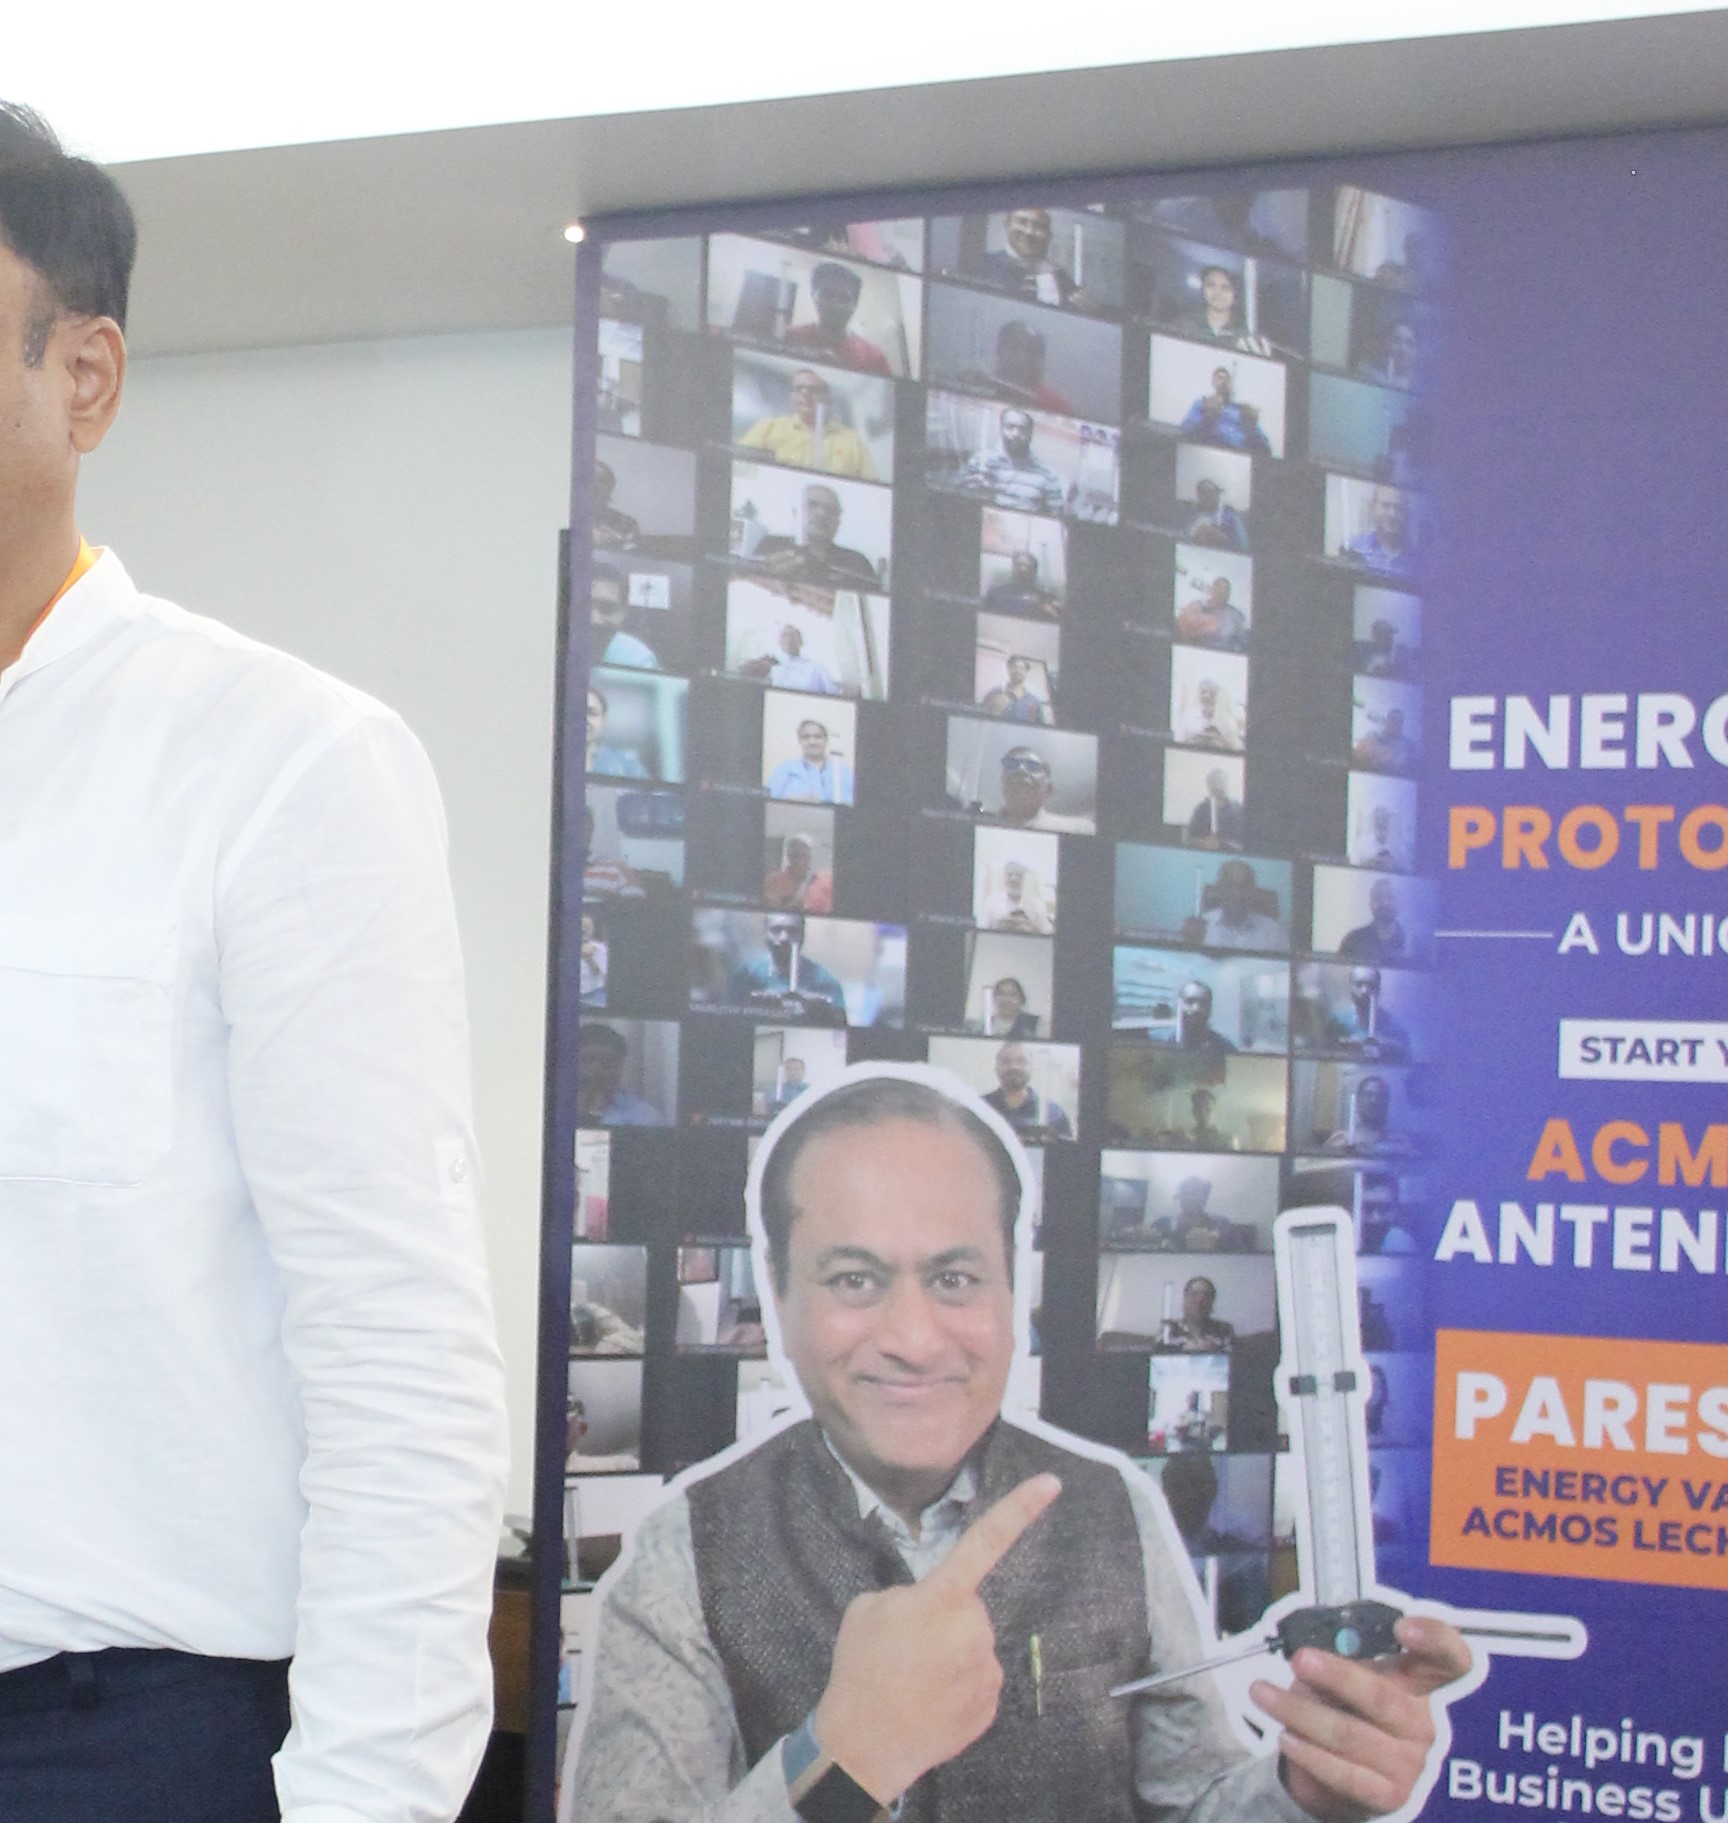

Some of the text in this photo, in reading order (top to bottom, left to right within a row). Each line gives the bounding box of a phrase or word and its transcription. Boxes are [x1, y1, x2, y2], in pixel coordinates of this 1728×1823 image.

[1448, 803, 1728, 871] PROTO
[1558, 911, 1728, 956] A UNI
[1580, 1037, 1704, 1067] START
[1527, 1117, 1728, 1188] ACM
[1434, 1199, 1728, 1275] ANTEN
[1495, 1466, 1669, 1509] ENERGY
[1462, 1507, 1618, 1549] ACMOS
[1498, 1710, 1704, 1780] Helping
[1448, 1758, 1682, 1823] Business
